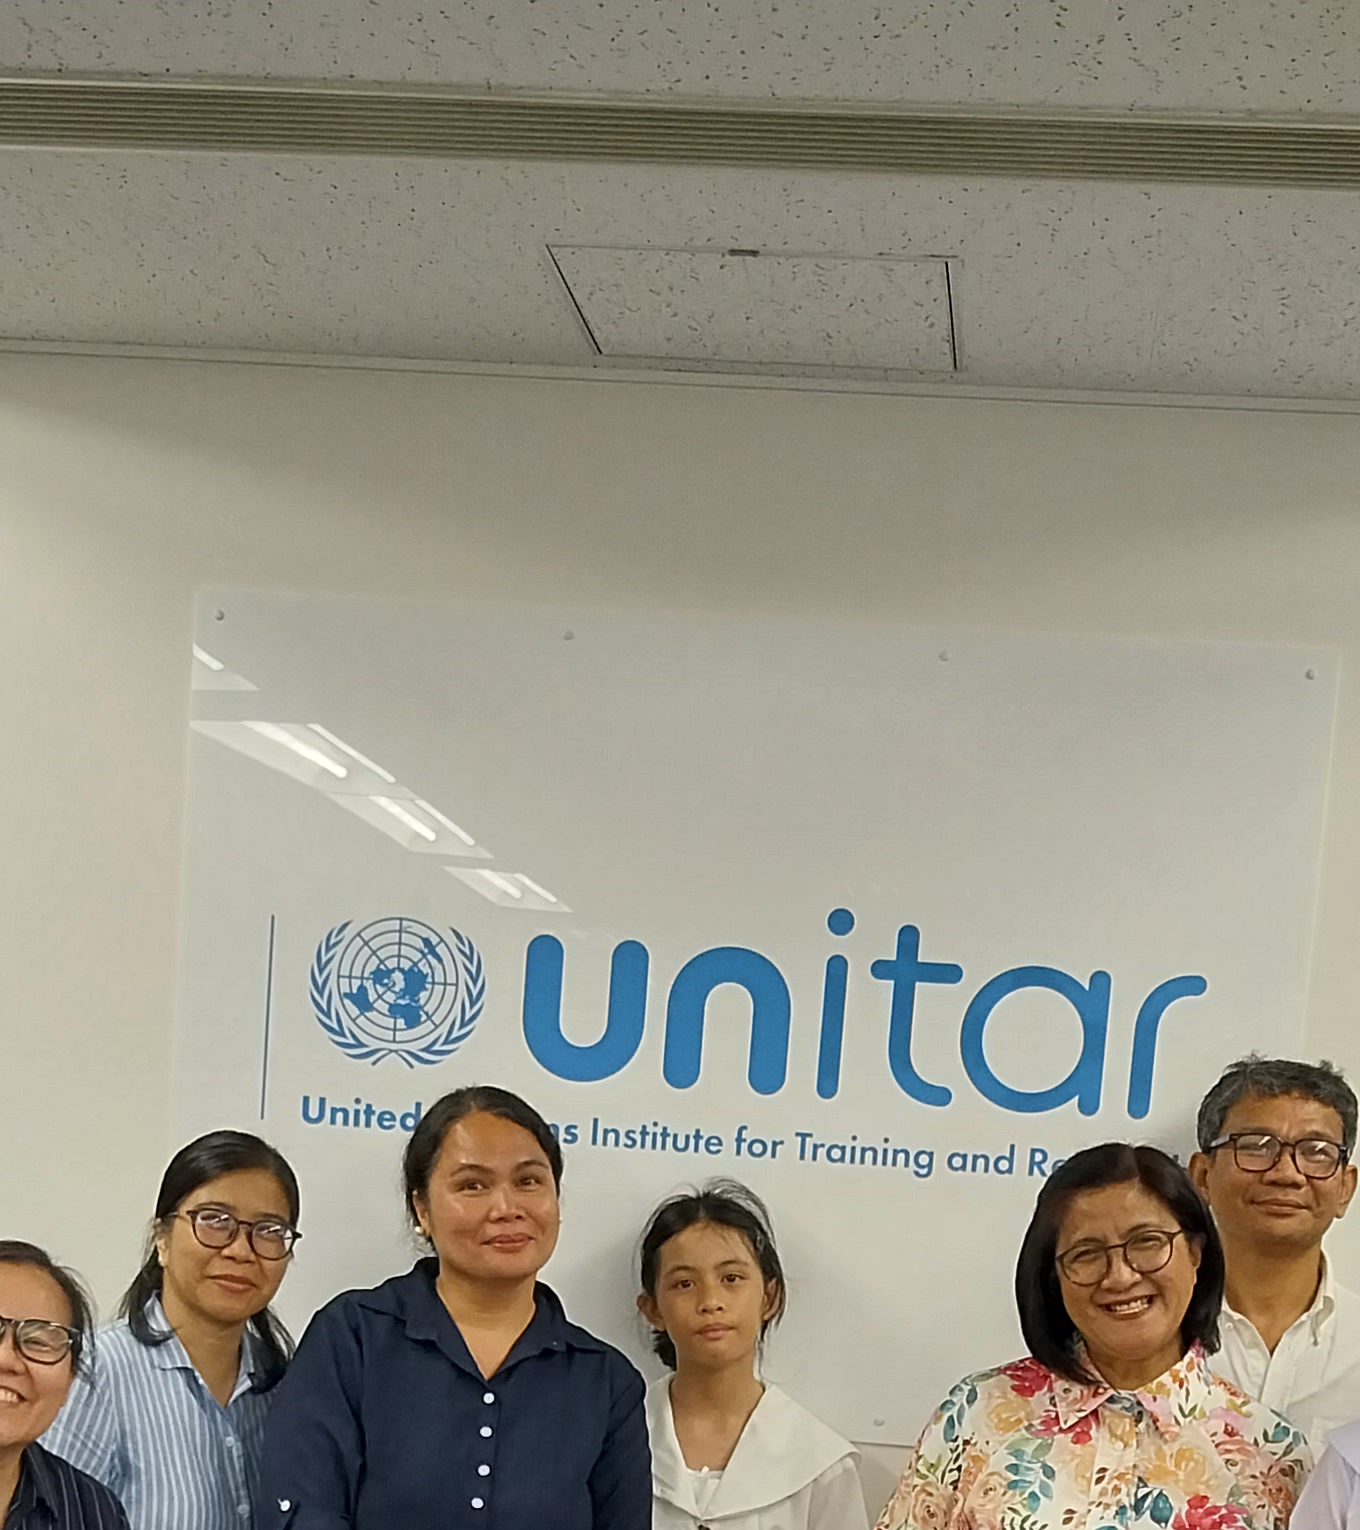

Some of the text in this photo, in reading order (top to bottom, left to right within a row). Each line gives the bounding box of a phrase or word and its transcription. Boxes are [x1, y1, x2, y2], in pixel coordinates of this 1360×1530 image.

[521, 907, 1208, 1120] unitar
[301, 1095, 423, 1132] United
[591, 1117, 724, 1155] Institute
[735, 1125, 785, 1159] for
[795, 1131, 934, 1178] Training
[946, 1144, 1016, 1176] and
